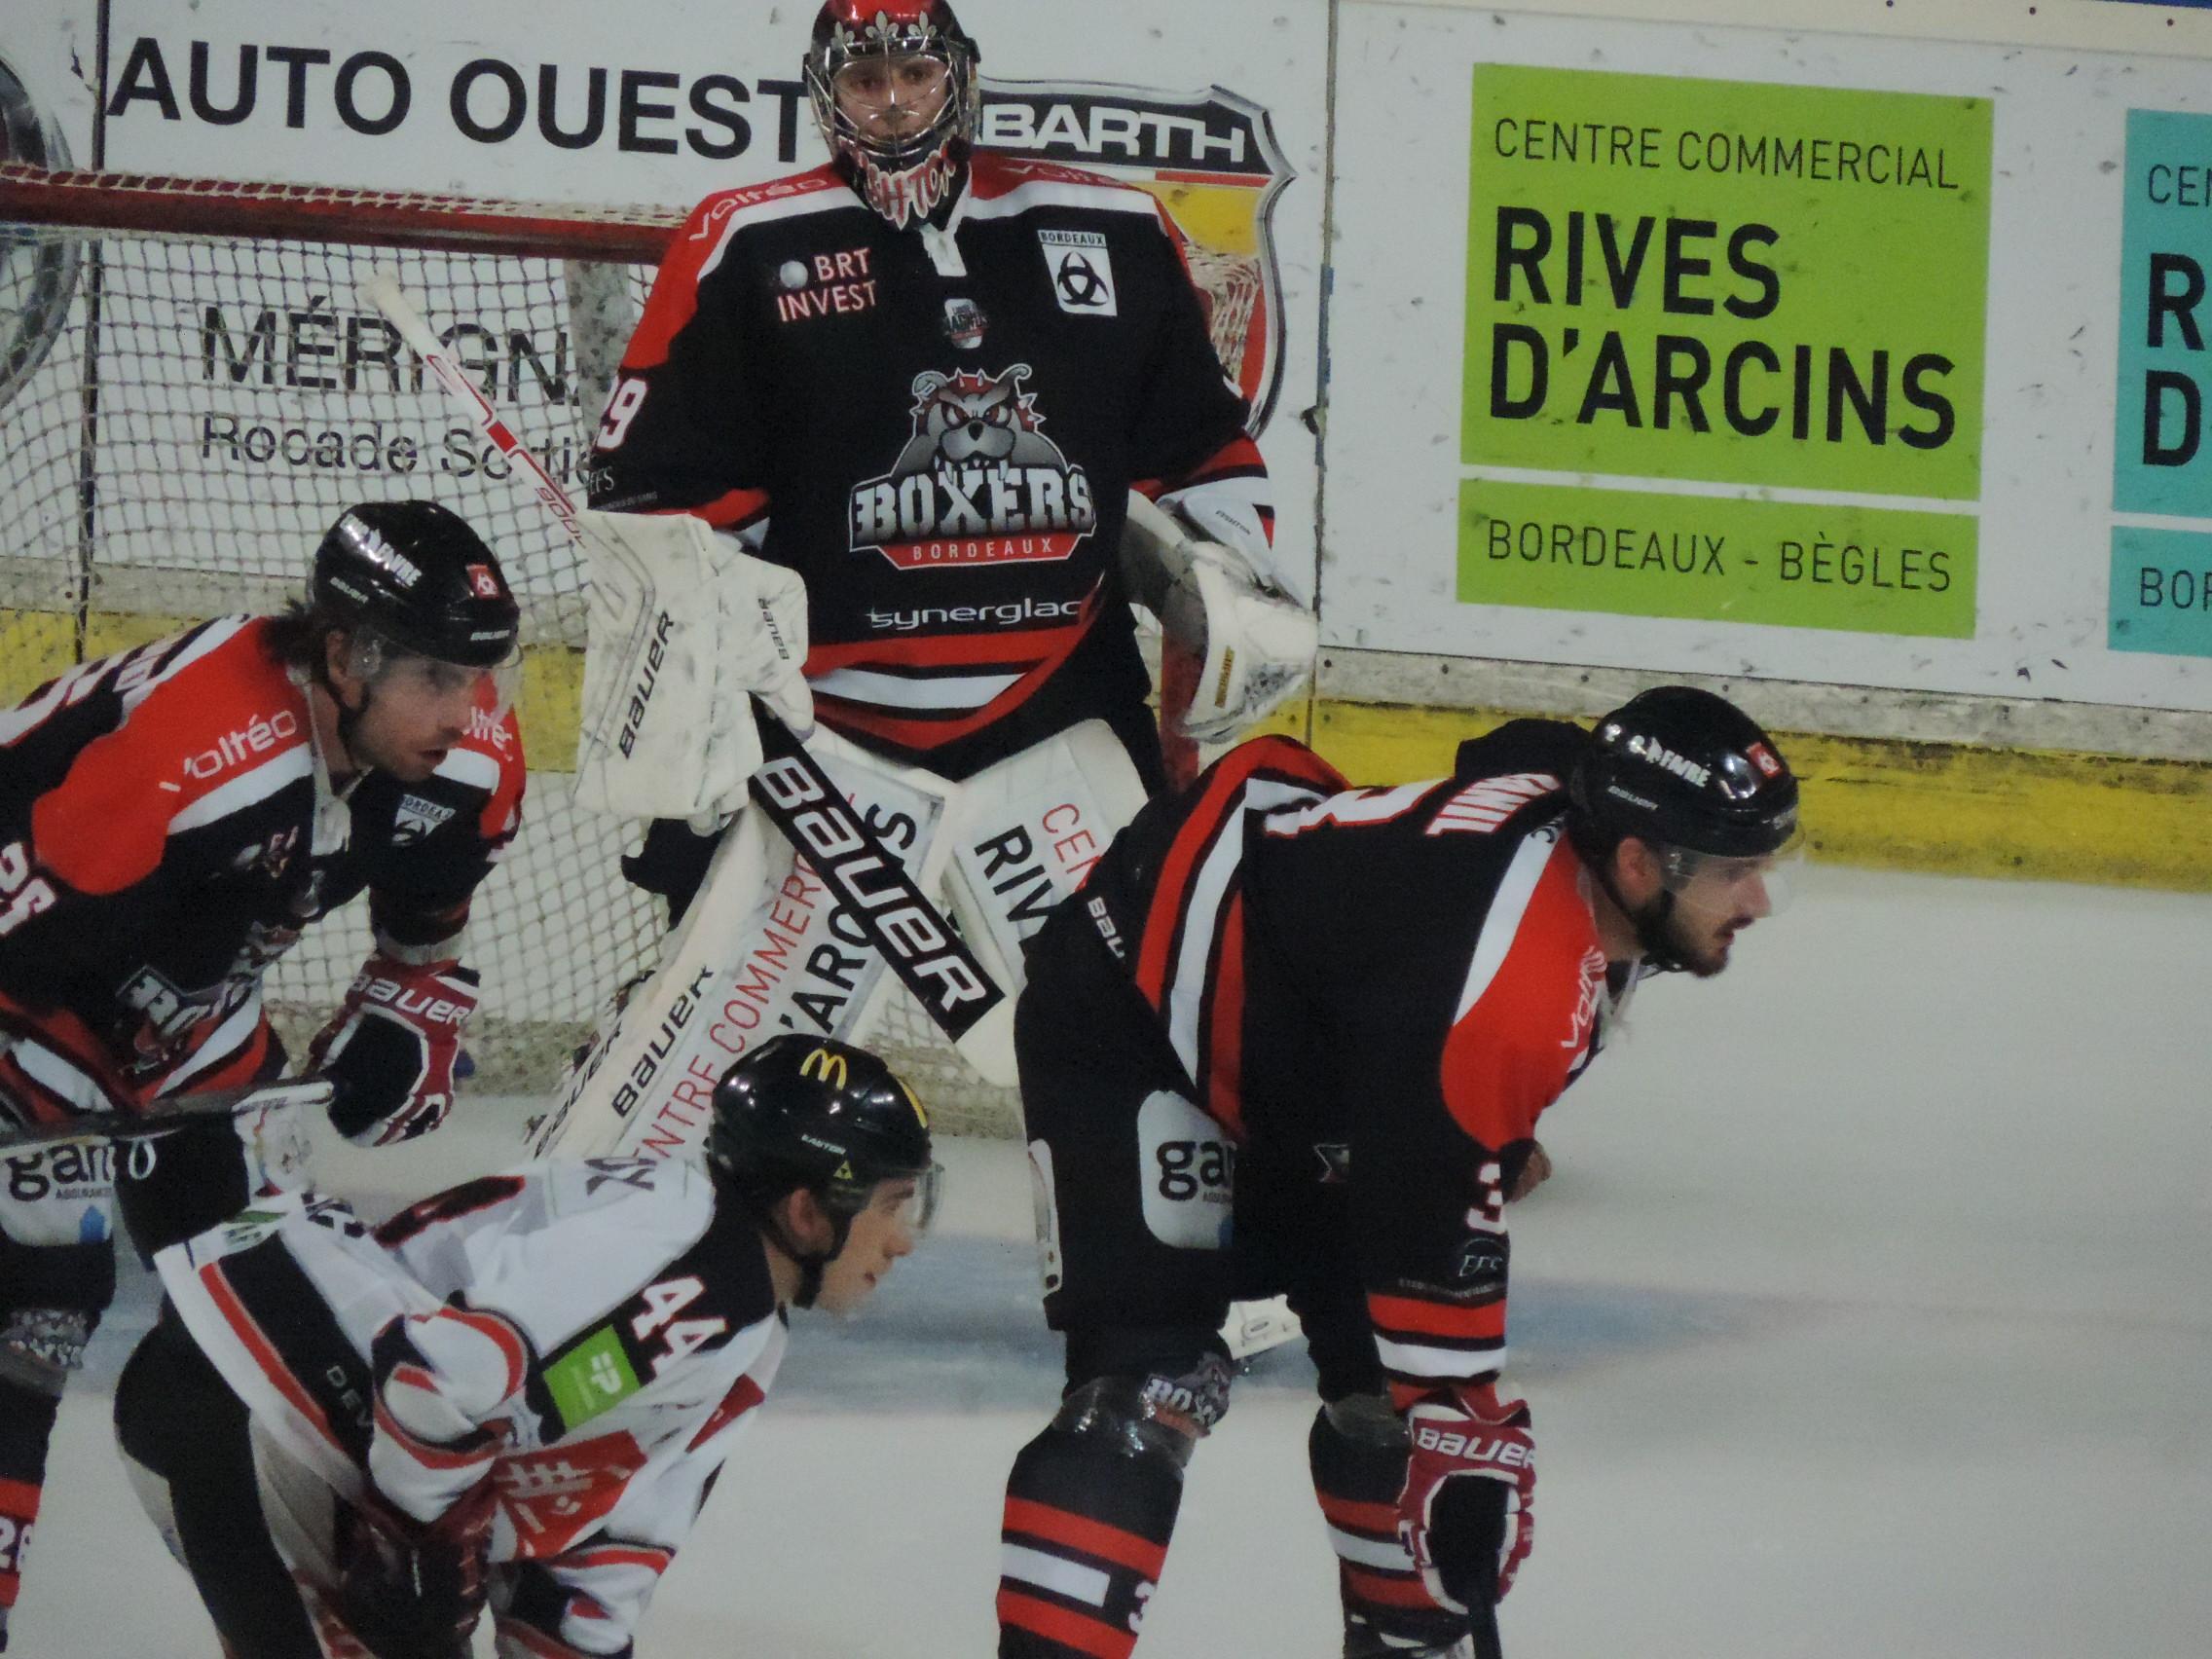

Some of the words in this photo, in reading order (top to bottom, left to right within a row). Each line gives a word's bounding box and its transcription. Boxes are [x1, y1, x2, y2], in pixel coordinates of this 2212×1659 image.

[105, 37, 413, 136] AUTO
[449, 58, 808, 164] OUEST
[975, 102, 1244, 164] BARTH
[1494, 118, 1662, 169] CENTRE
[1678, 130, 1960, 191] COMMERCIAL
[2148, 163, 2212, 208] CE
[814, 247, 870, 280] BRT
[1040, 231, 1107, 247] BORDEAUX
[1493, 205, 1781, 320] RIVES
[778, 280, 876, 322] INVEST
[203, 295, 581, 407] MÉRIGN
[1489, 322, 1957, 450] D'ARCINS
[203, 411, 418, 474] Rocade
[855, 467, 1095, 538] BOXERS
[912, 537, 1053, 562] BORDEAUX
[1487, 519, 1726, 577] BORDEAUX
[1780, 532, 1951, 593] BÈGLES
[759, 755, 987, 1013] BAUER
[632, 1276, 729, 1379] 44
